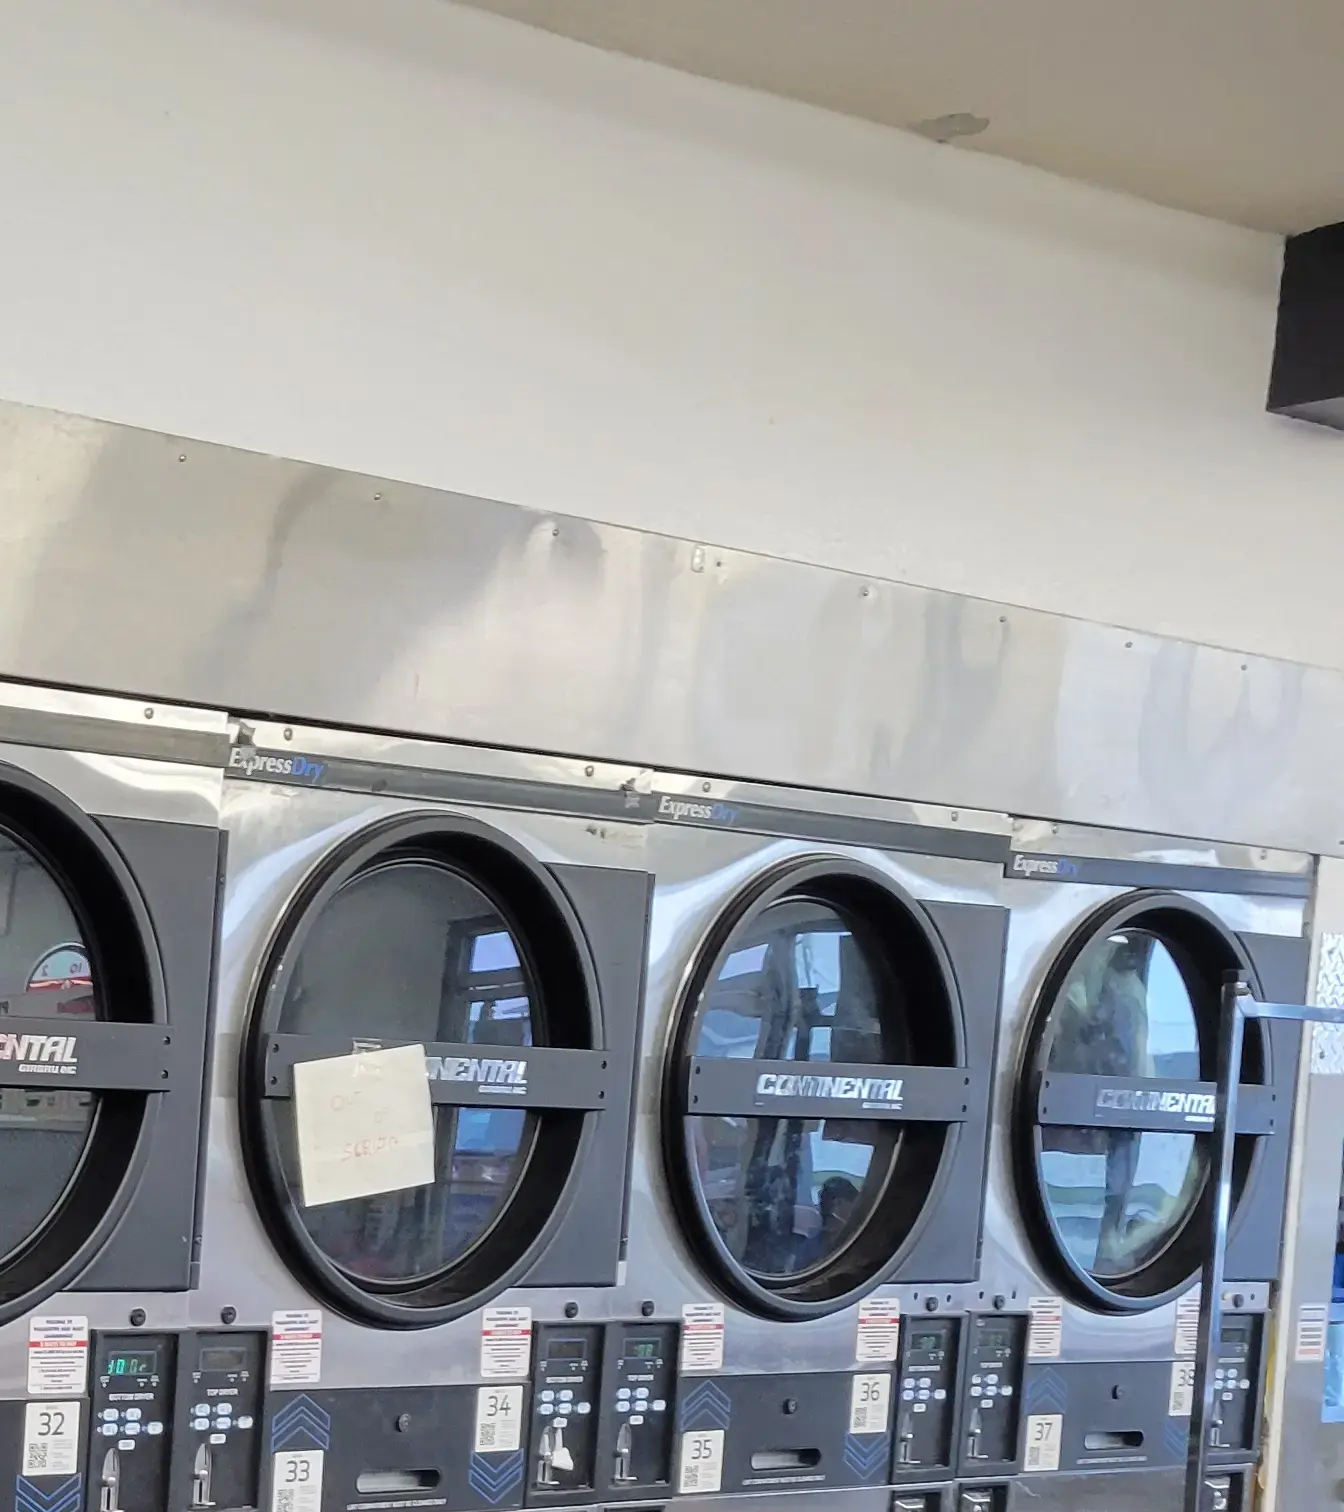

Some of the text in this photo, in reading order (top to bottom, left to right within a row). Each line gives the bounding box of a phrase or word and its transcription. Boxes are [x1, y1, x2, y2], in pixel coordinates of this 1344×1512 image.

[756, 1073, 904, 1101] CONTINENTAL
[860, 1382, 880, 1402] 36
[487, 1395, 511, 1417] 34
[38, 1412, 65, 1436] 32
[1034, 1422, 1053, 1441] 37
[691, 1439, 712, 1460] 35
[285, 1460, 310, 1483] 33
